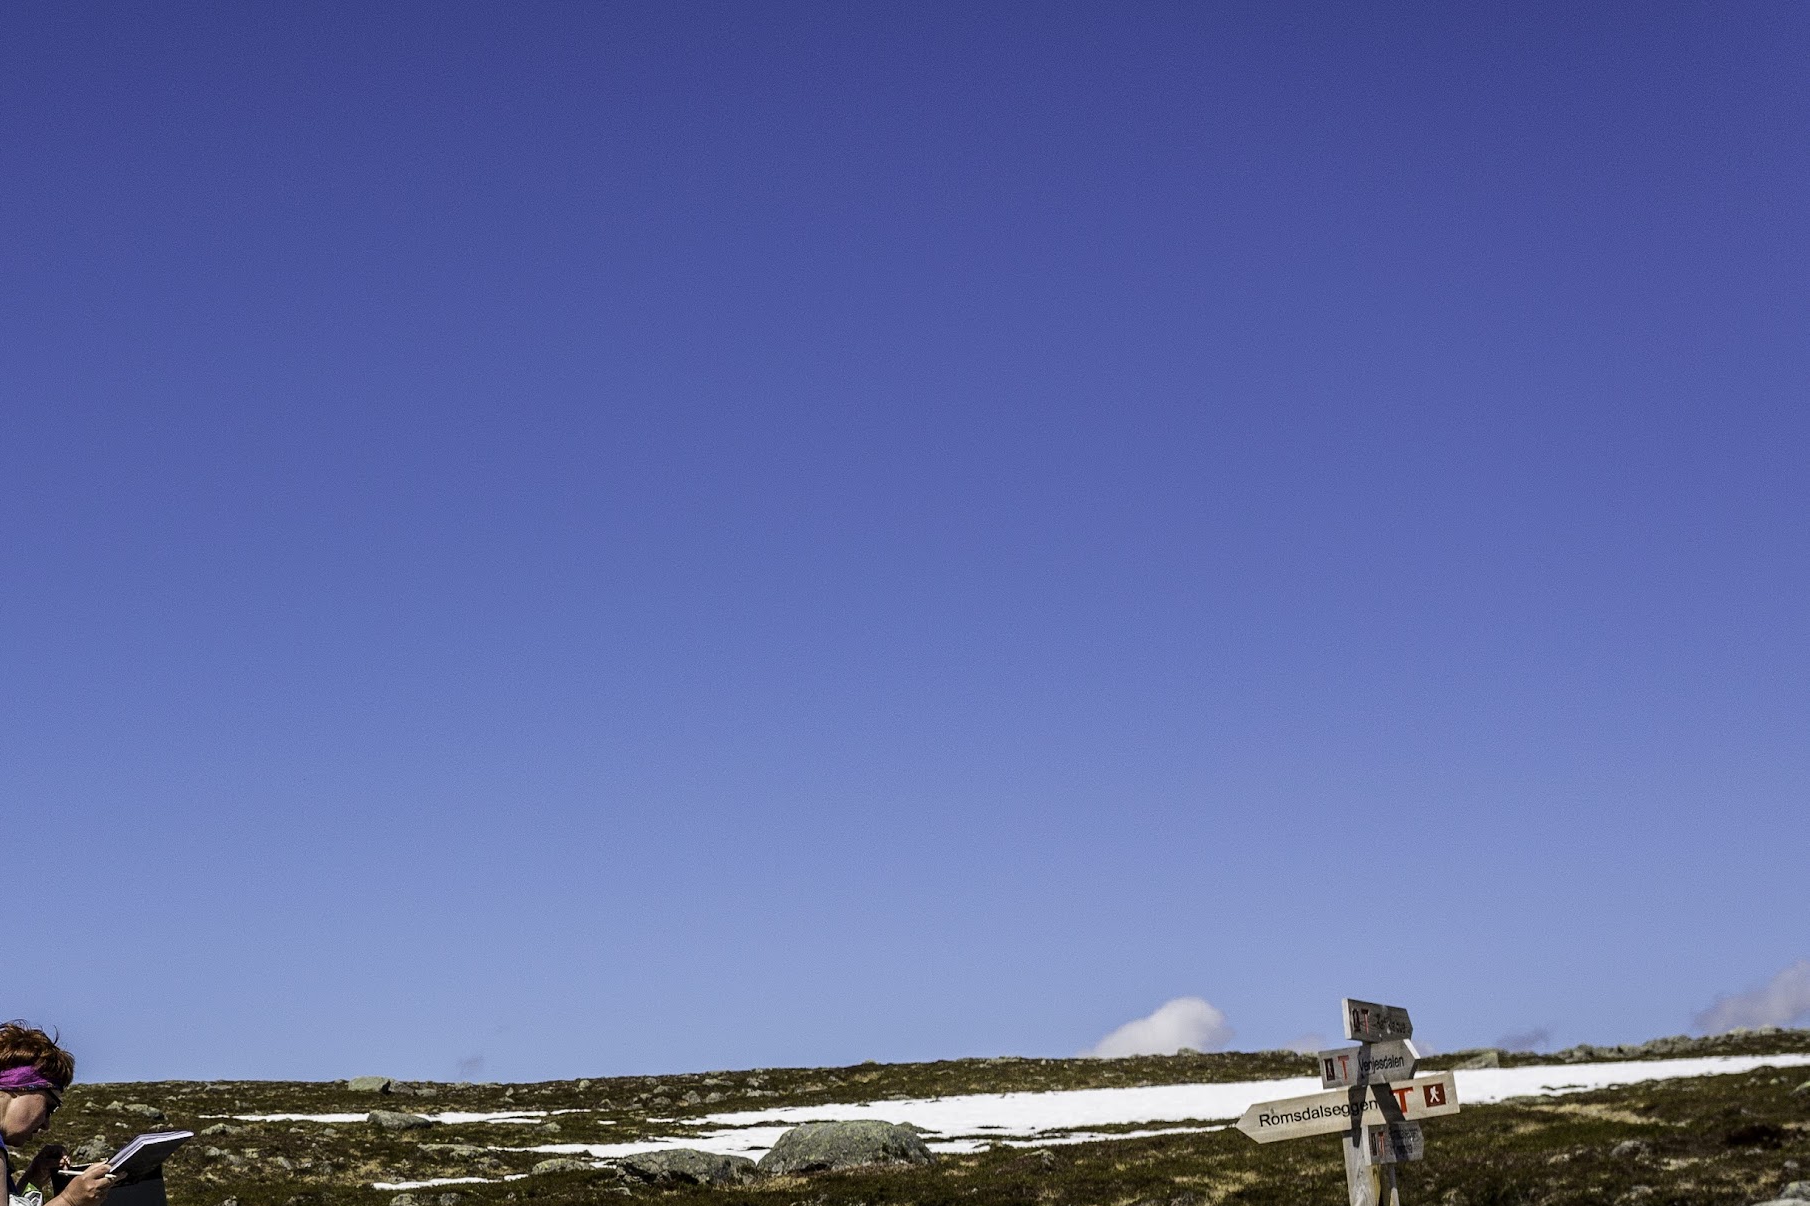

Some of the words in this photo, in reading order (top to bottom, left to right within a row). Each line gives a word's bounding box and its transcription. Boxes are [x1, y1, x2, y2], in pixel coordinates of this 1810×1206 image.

[1361, 1009, 1369, 1035] T
[1337, 1055, 1349, 1081] T
[1358, 1056, 1405, 1074] Venjesdalen
[1259, 1099, 1378, 1127] Romsdalseggen
[1390, 1087, 1414, 1114] T
